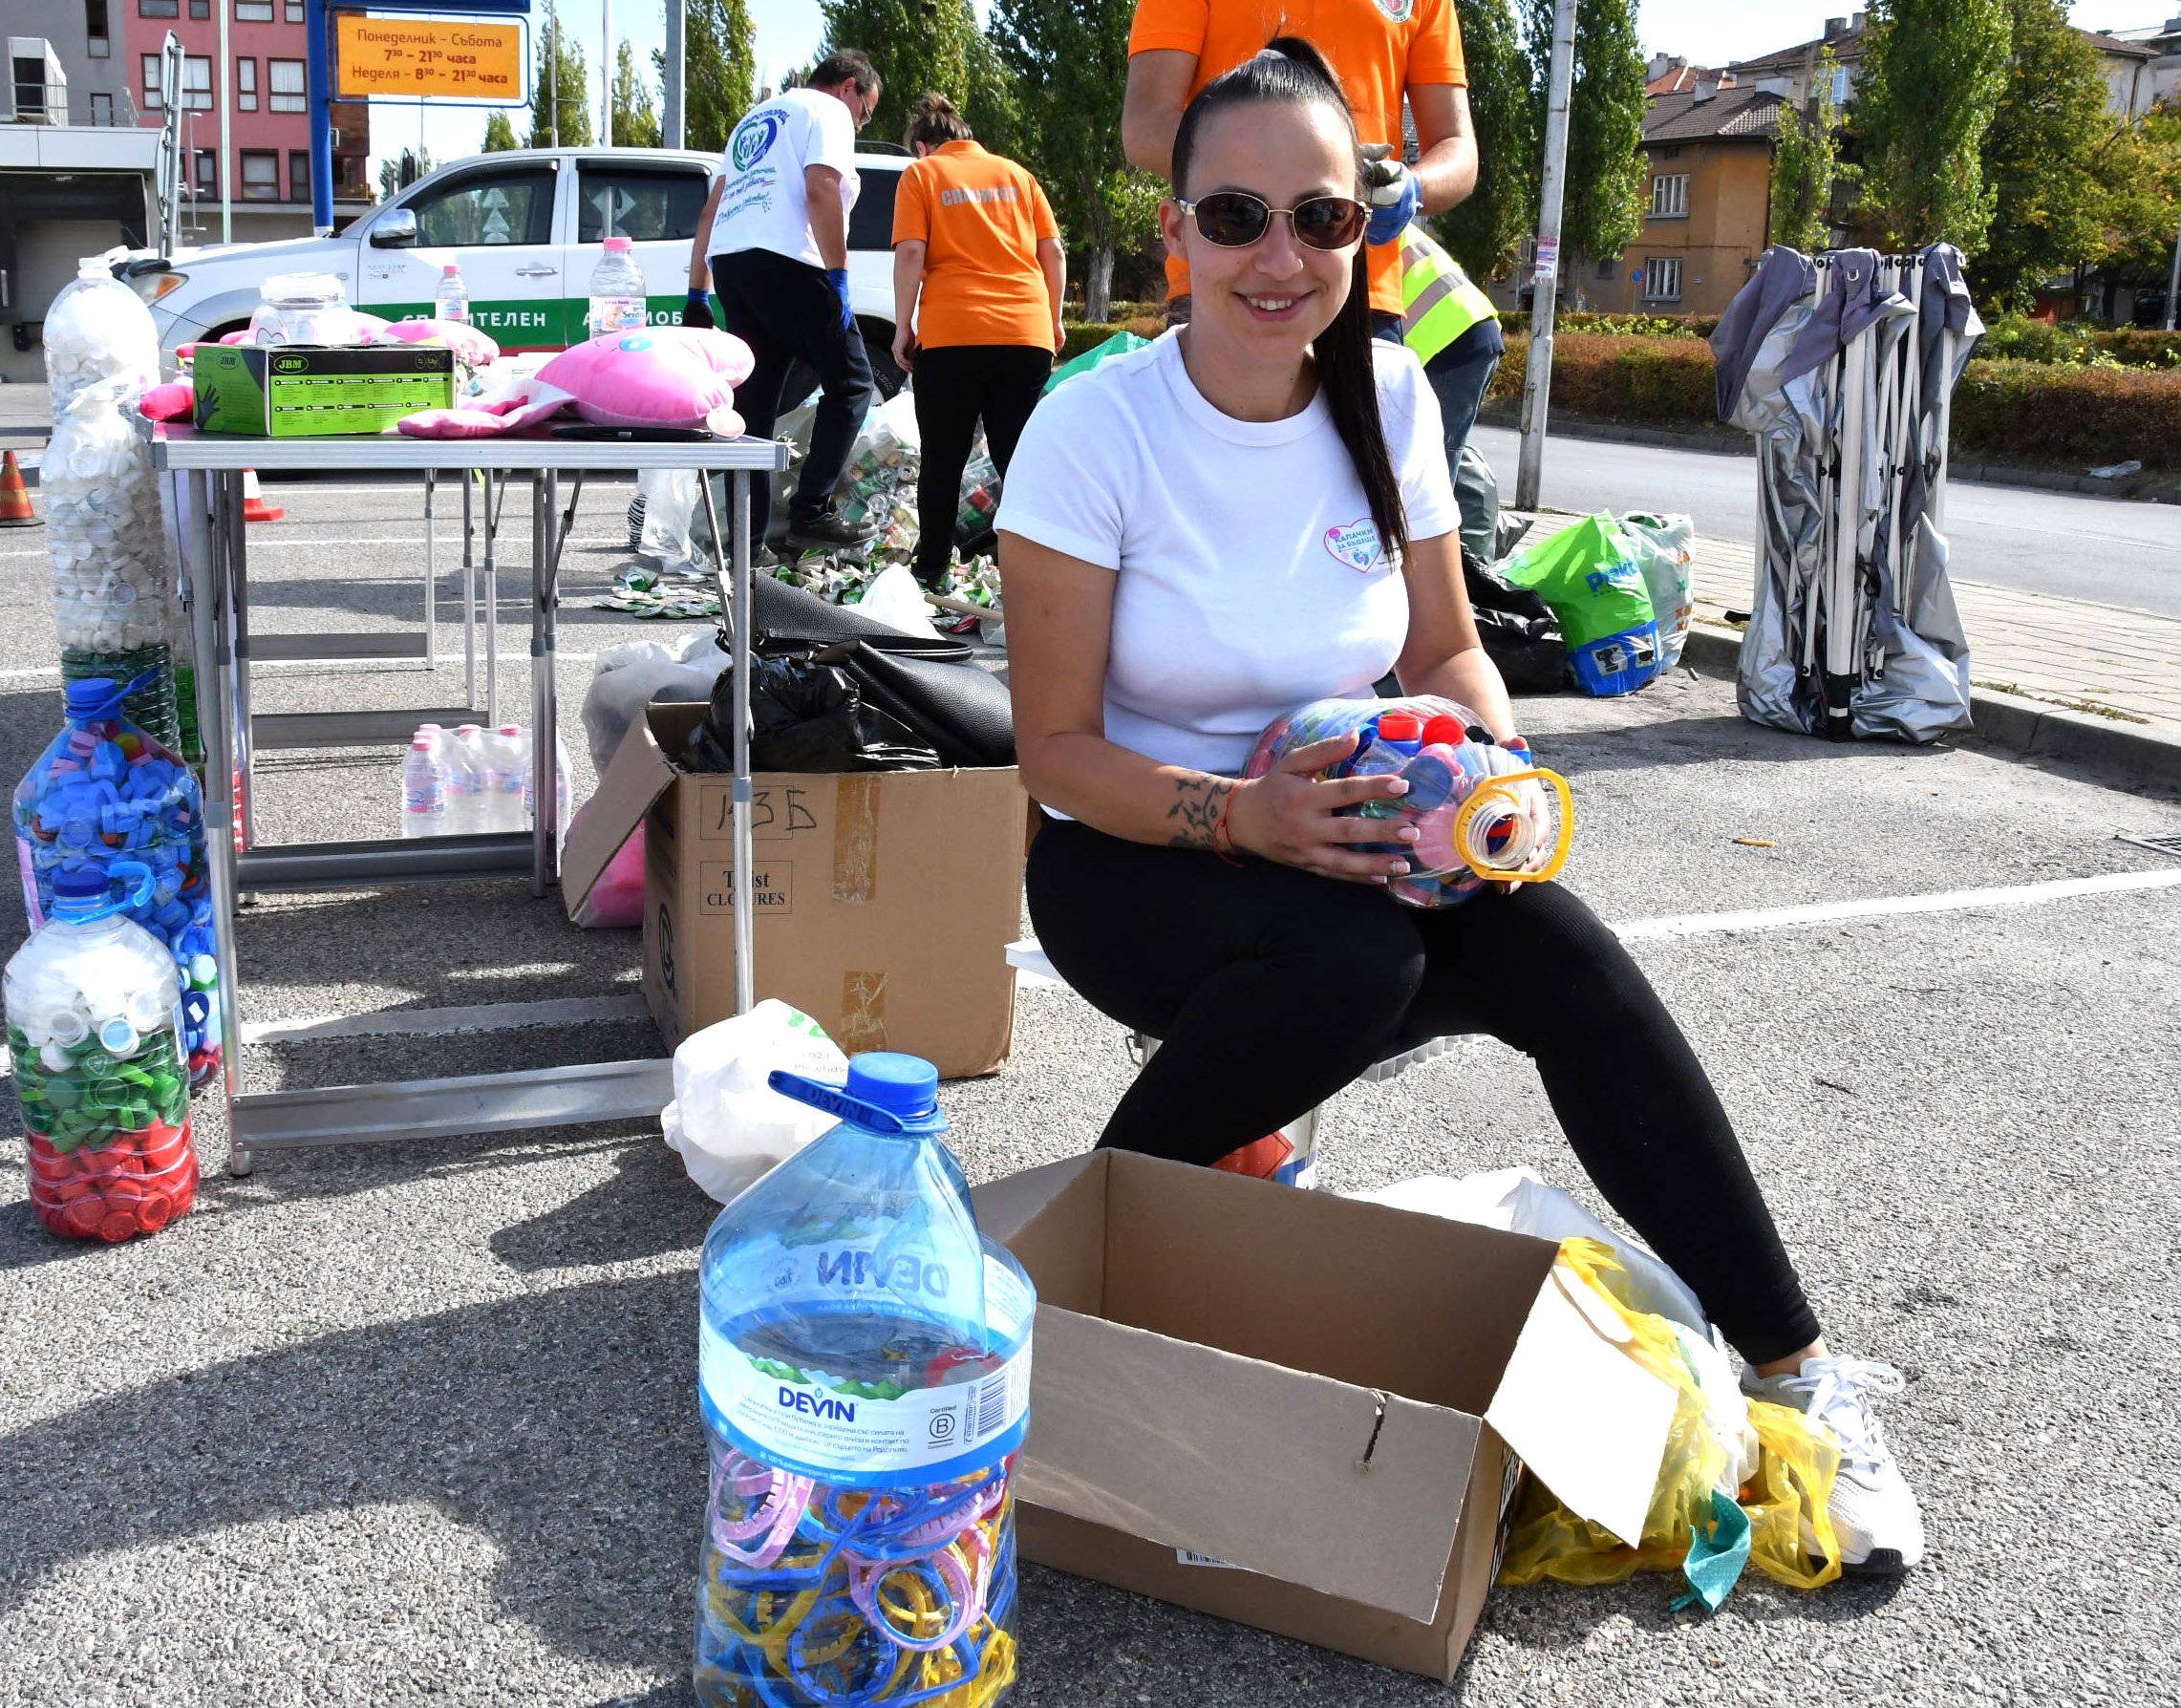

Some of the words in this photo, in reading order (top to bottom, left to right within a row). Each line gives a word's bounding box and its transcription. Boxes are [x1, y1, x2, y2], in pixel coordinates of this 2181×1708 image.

[357, 29, 437, 46] Понеделник
[451, 32, 502, 48] Събота
[447, 54, 477, 65] часа
[352, 66, 400, 81] Неделя
[479, 74, 508, 84] часа
[403, 311, 546, 328] ИТЕЛЕН
[221, 356, 236, 366] JBM
[279, 359, 302, 369] JBM
[1335, 528, 1374, 544] КАПАЧКИ
[1336, 542, 1346, 550] ЗА
[1346, 536, 1376, 548] БЪДЕЩЕ
[723, 870, 771, 888] Tist
[707, 892, 785, 906] CLORES
[808, 1086, 862, 1121] DEVIN
[779, 1386, 855, 1422] DEVIN
[930, 1404, 957, 1414] Certified
